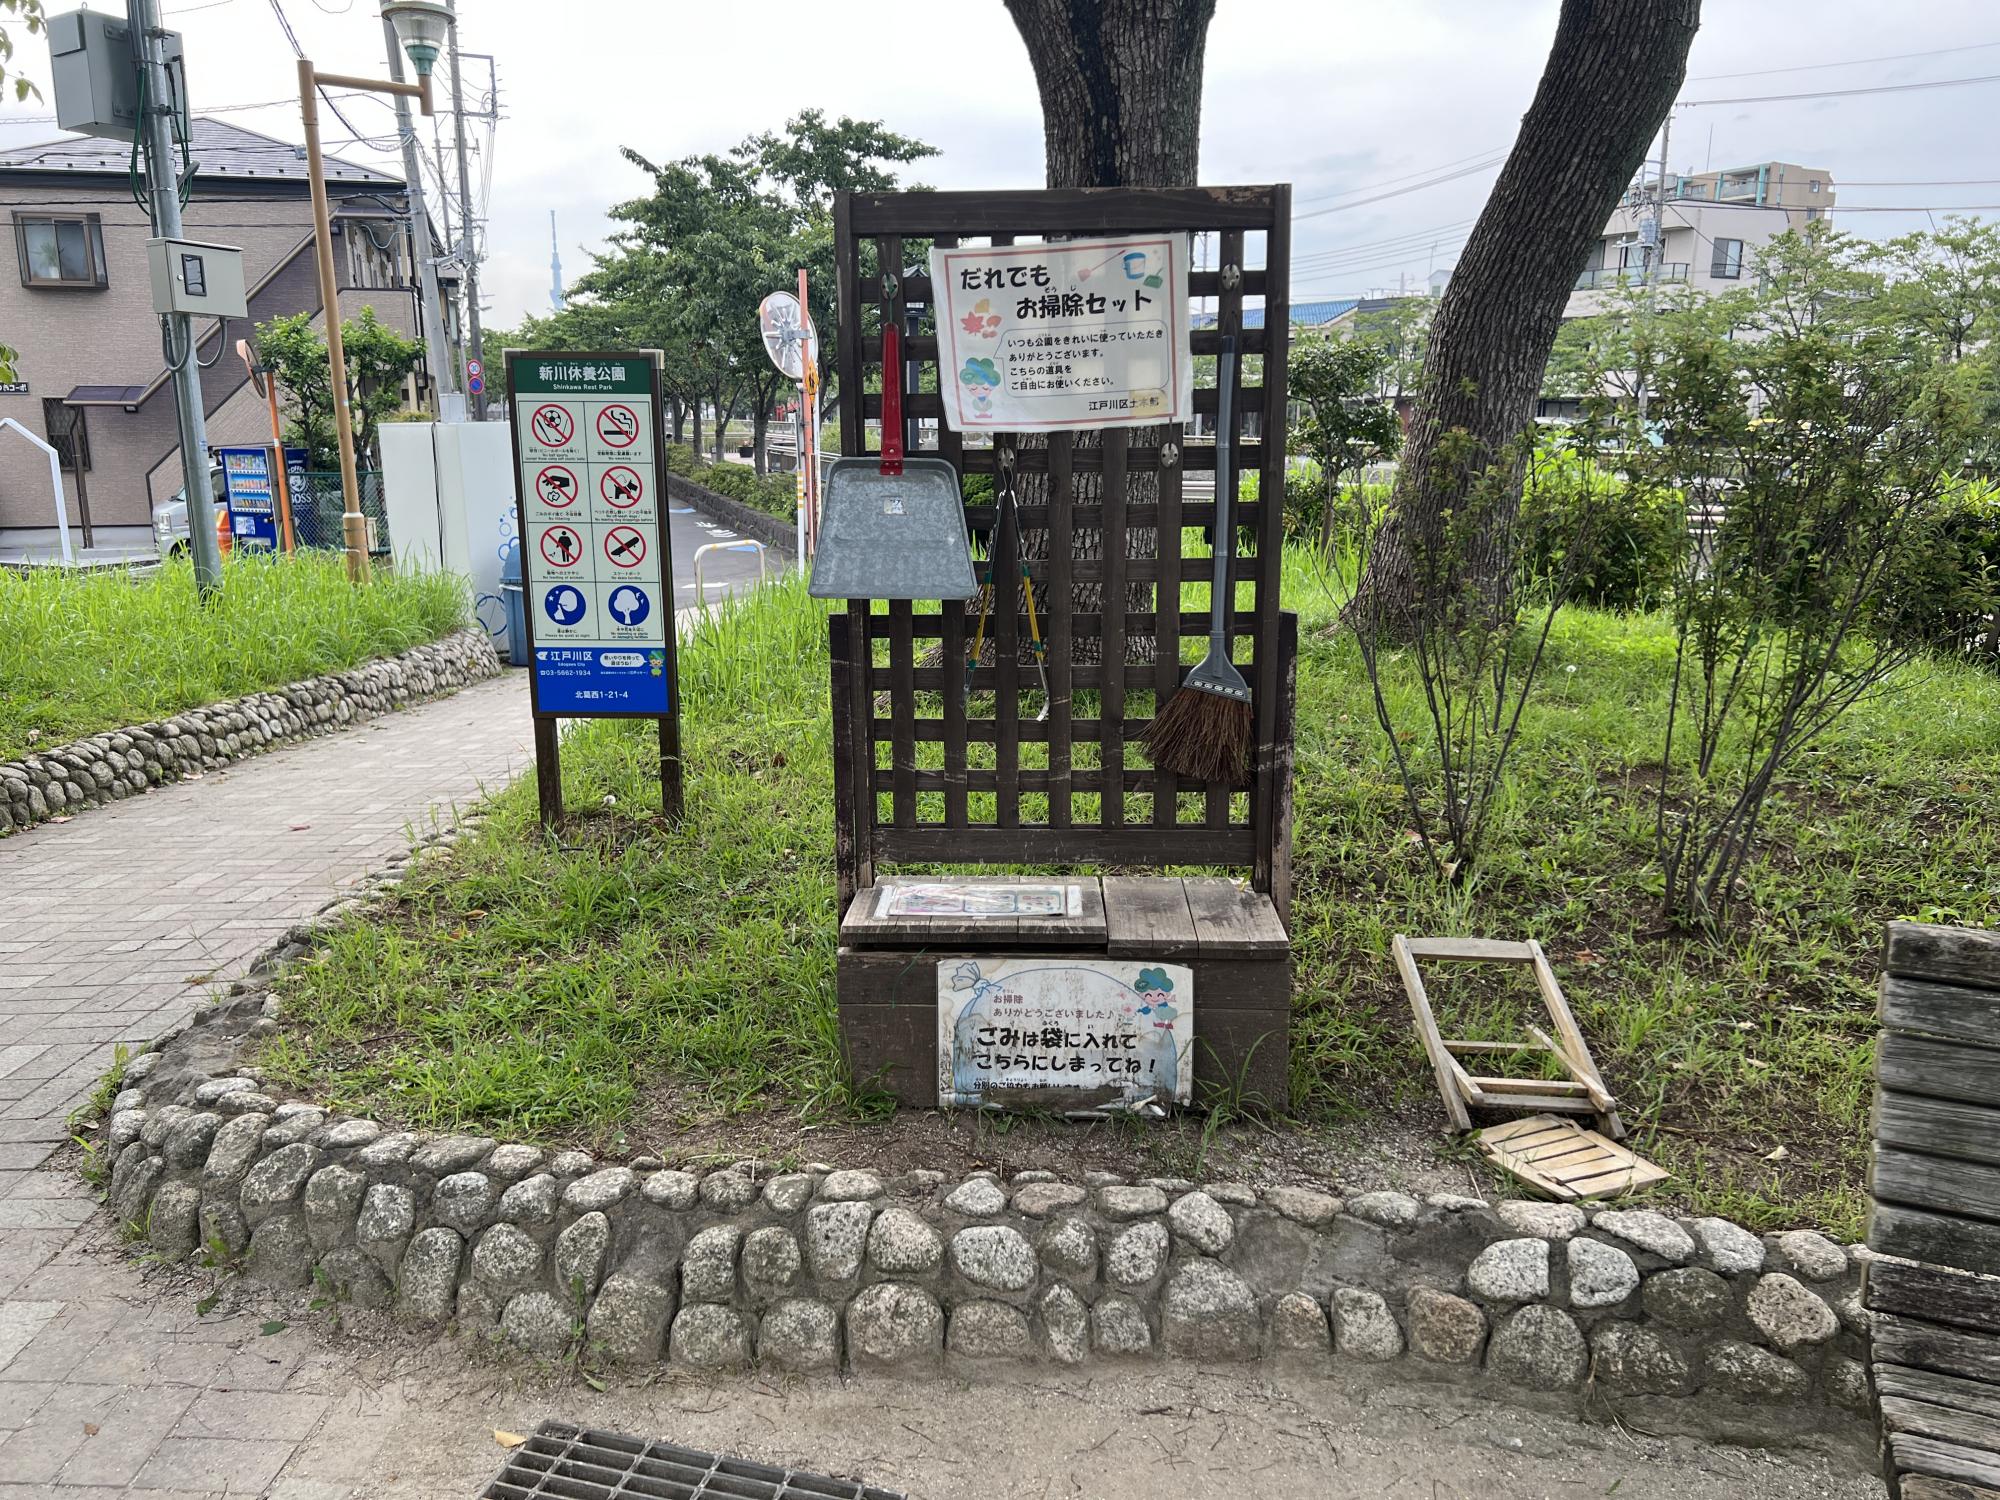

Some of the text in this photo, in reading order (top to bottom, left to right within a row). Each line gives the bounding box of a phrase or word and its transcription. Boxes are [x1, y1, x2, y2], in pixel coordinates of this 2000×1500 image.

[960, 264, 1051, 290] だれでも
[1016, 289, 1152, 319] お掃除セット
[1008, 329, 1164, 347] いつも公園をきれいに使っていただき
[1009, 348, 1104, 362] ありがとうございます。
[539, 366, 626, 381] 新川休養公園
[1010, 365, 1072, 376] こちらの道具を
[1011, 377, 1114, 390] ご自由にお使いください。
[551, 651, 593, 661] 江戸川区
[575, 690, 629, 699] 北葛西1-21-4
[993, 994, 1024, 1004] お掃除
[976, 1027, 1138, 1050] ごみは袋に入れて
